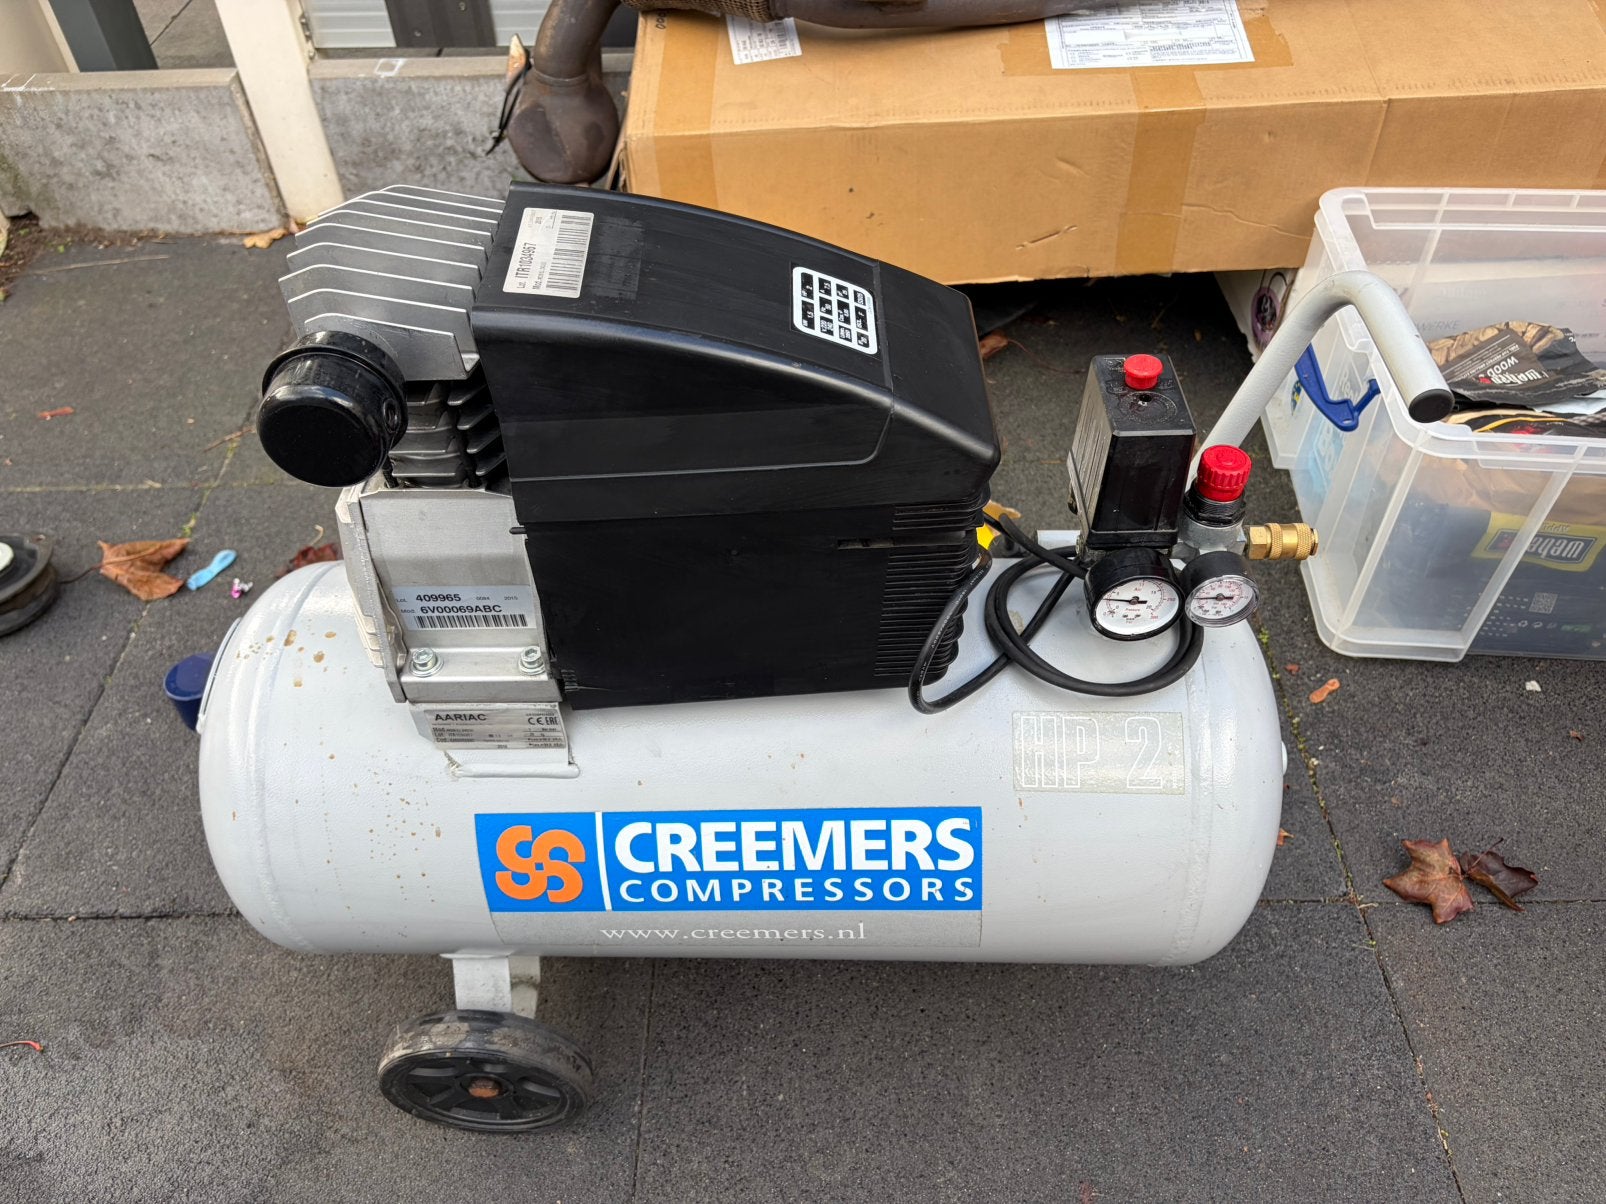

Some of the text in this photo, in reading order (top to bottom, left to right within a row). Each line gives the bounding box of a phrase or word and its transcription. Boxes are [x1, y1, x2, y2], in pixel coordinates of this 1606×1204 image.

[1486, 355, 1519, 379] WOOD
[1527, 537, 1585, 559] webe
[416, 593, 462, 602] 409965
[420, 604, 503, 614] 6V00069ABC
[435, 713, 487, 721] AARIAC
[1021, 716, 1163, 789] HP 2
[614, 817, 975, 874] CREEMERS
[619, 877, 975, 903] COMPRESSORS
[599, 922, 867, 941] www.creemers.nl
